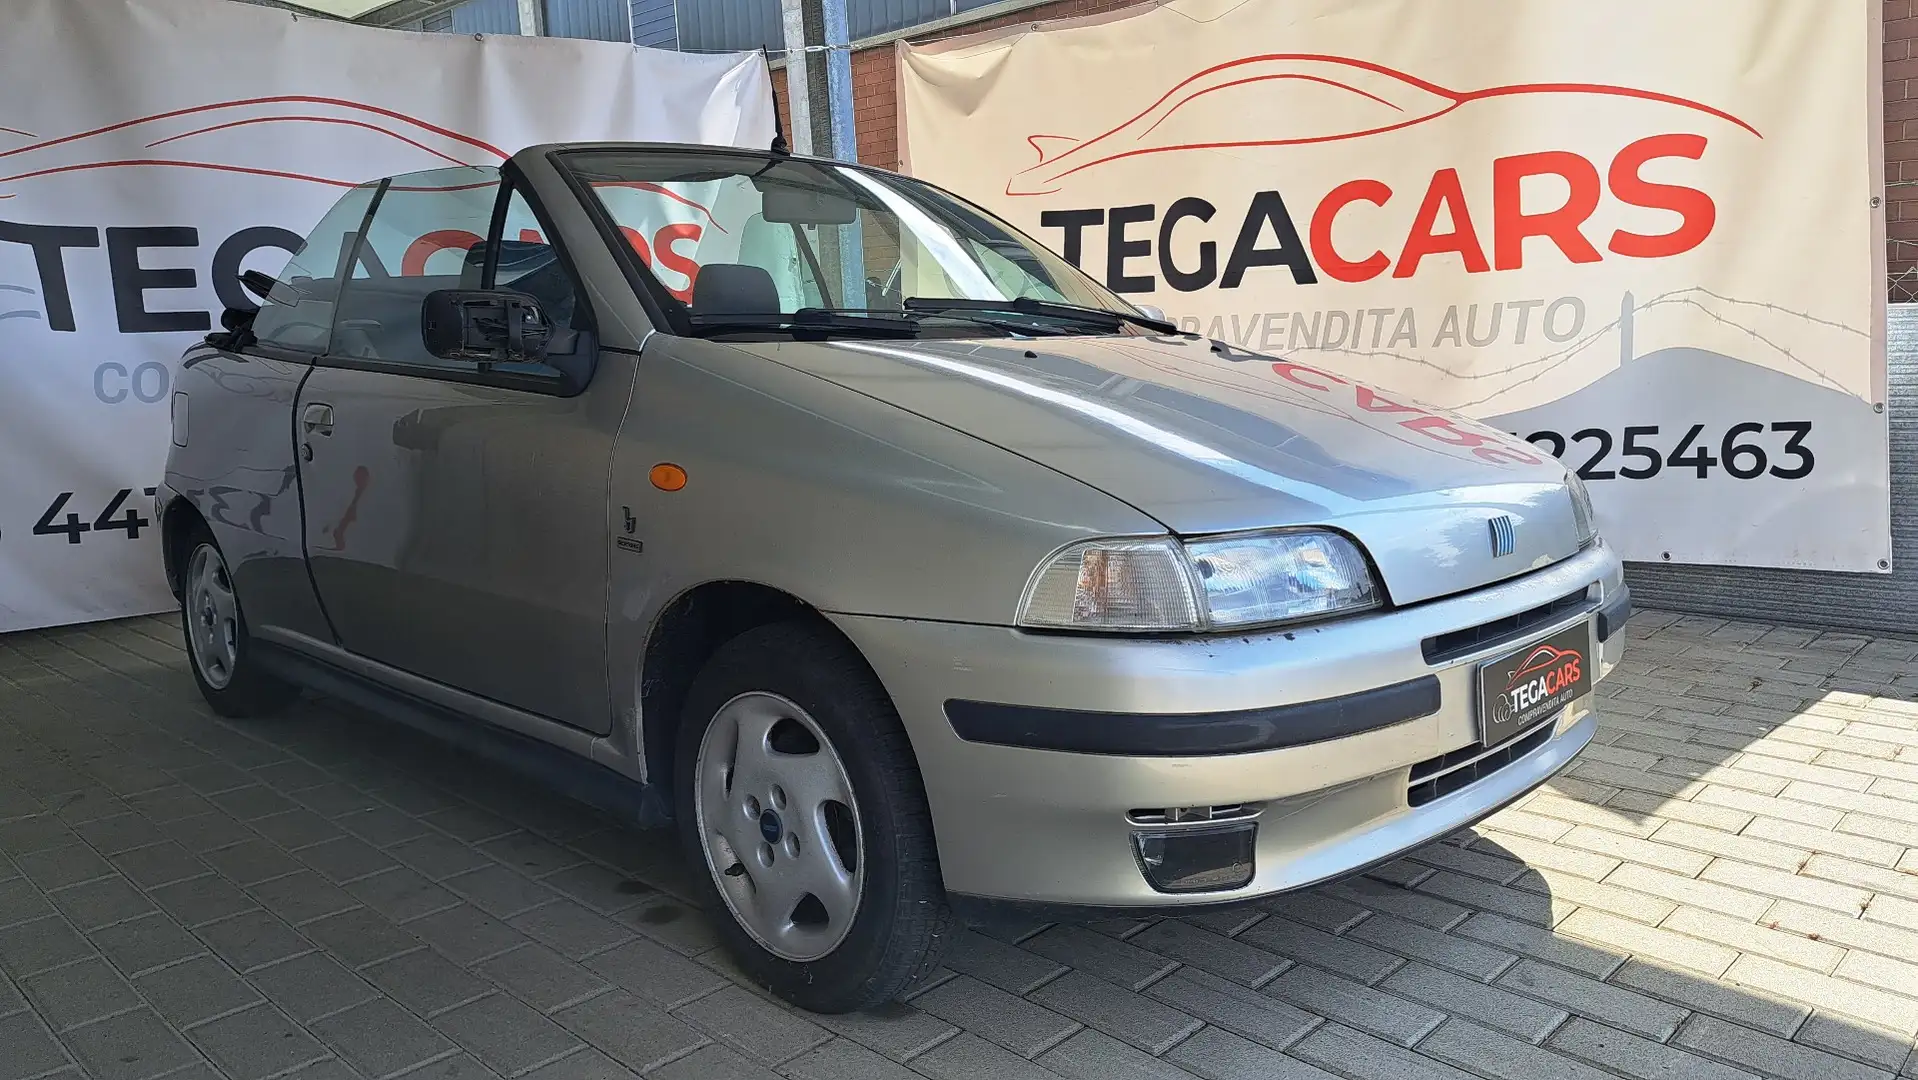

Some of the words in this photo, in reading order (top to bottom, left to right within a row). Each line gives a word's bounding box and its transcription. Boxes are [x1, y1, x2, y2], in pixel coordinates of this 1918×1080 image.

[1041, 133, 1716, 293] TEGACARS
[1432, 296, 1586, 349] AUTO
[1510, 658, 1581, 713] TEGACARS
[1559, 688, 1574, 705] AUTO
